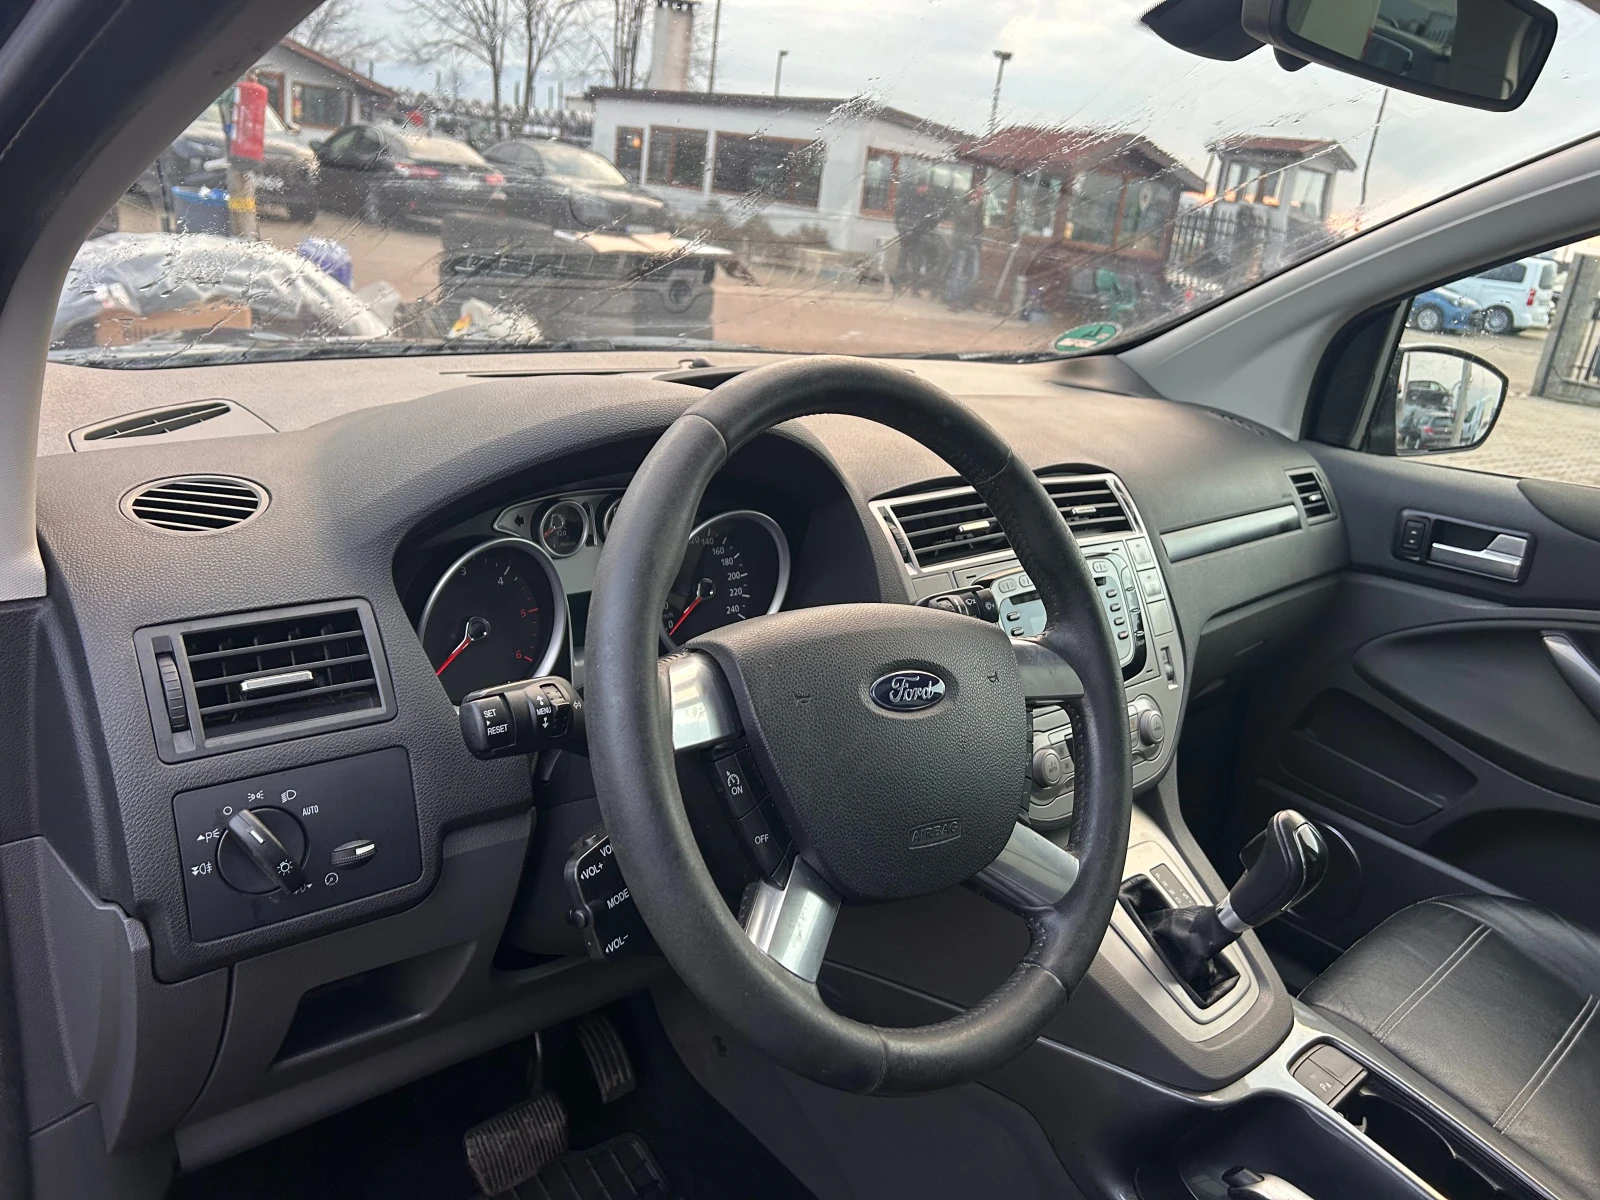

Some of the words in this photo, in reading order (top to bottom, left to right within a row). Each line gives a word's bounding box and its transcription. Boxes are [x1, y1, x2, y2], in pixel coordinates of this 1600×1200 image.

[689, 535, 700, 545] 20
[701, 537, 714, 546] 140
[712, 546, 725, 556] 160
[721, 557, 734, 566] 180
[461, 566, 467, 576] 3
[727, 571, 741, 581] 200
[497, 576, 504, 585] 4
[729, 587, 743, 597] 220
[520, 608, 527, 618] 5
[726, 604, 740, 614] 240
[668, 620, 674, 629] 0
[515, 650, 522, 659] 6
[888, 675, 935, 703] Ford
[483, 708, 497, 718] SET
[536, 706, 552, 716] MENU
[487, 723, 508, 736] RESET
[731, 785, 744, 796] ON
[302, 804, 319, 817] AUTO
[911, 820, 960, 844] AIRBAG
[754, 833, 769, 845] OFF
[600, 844, 613, 857] VO
[582, 862, 604, 880] VOL+
[606, 888, 630, 909] MODE
[607, 934, 629, 953] VOL-
